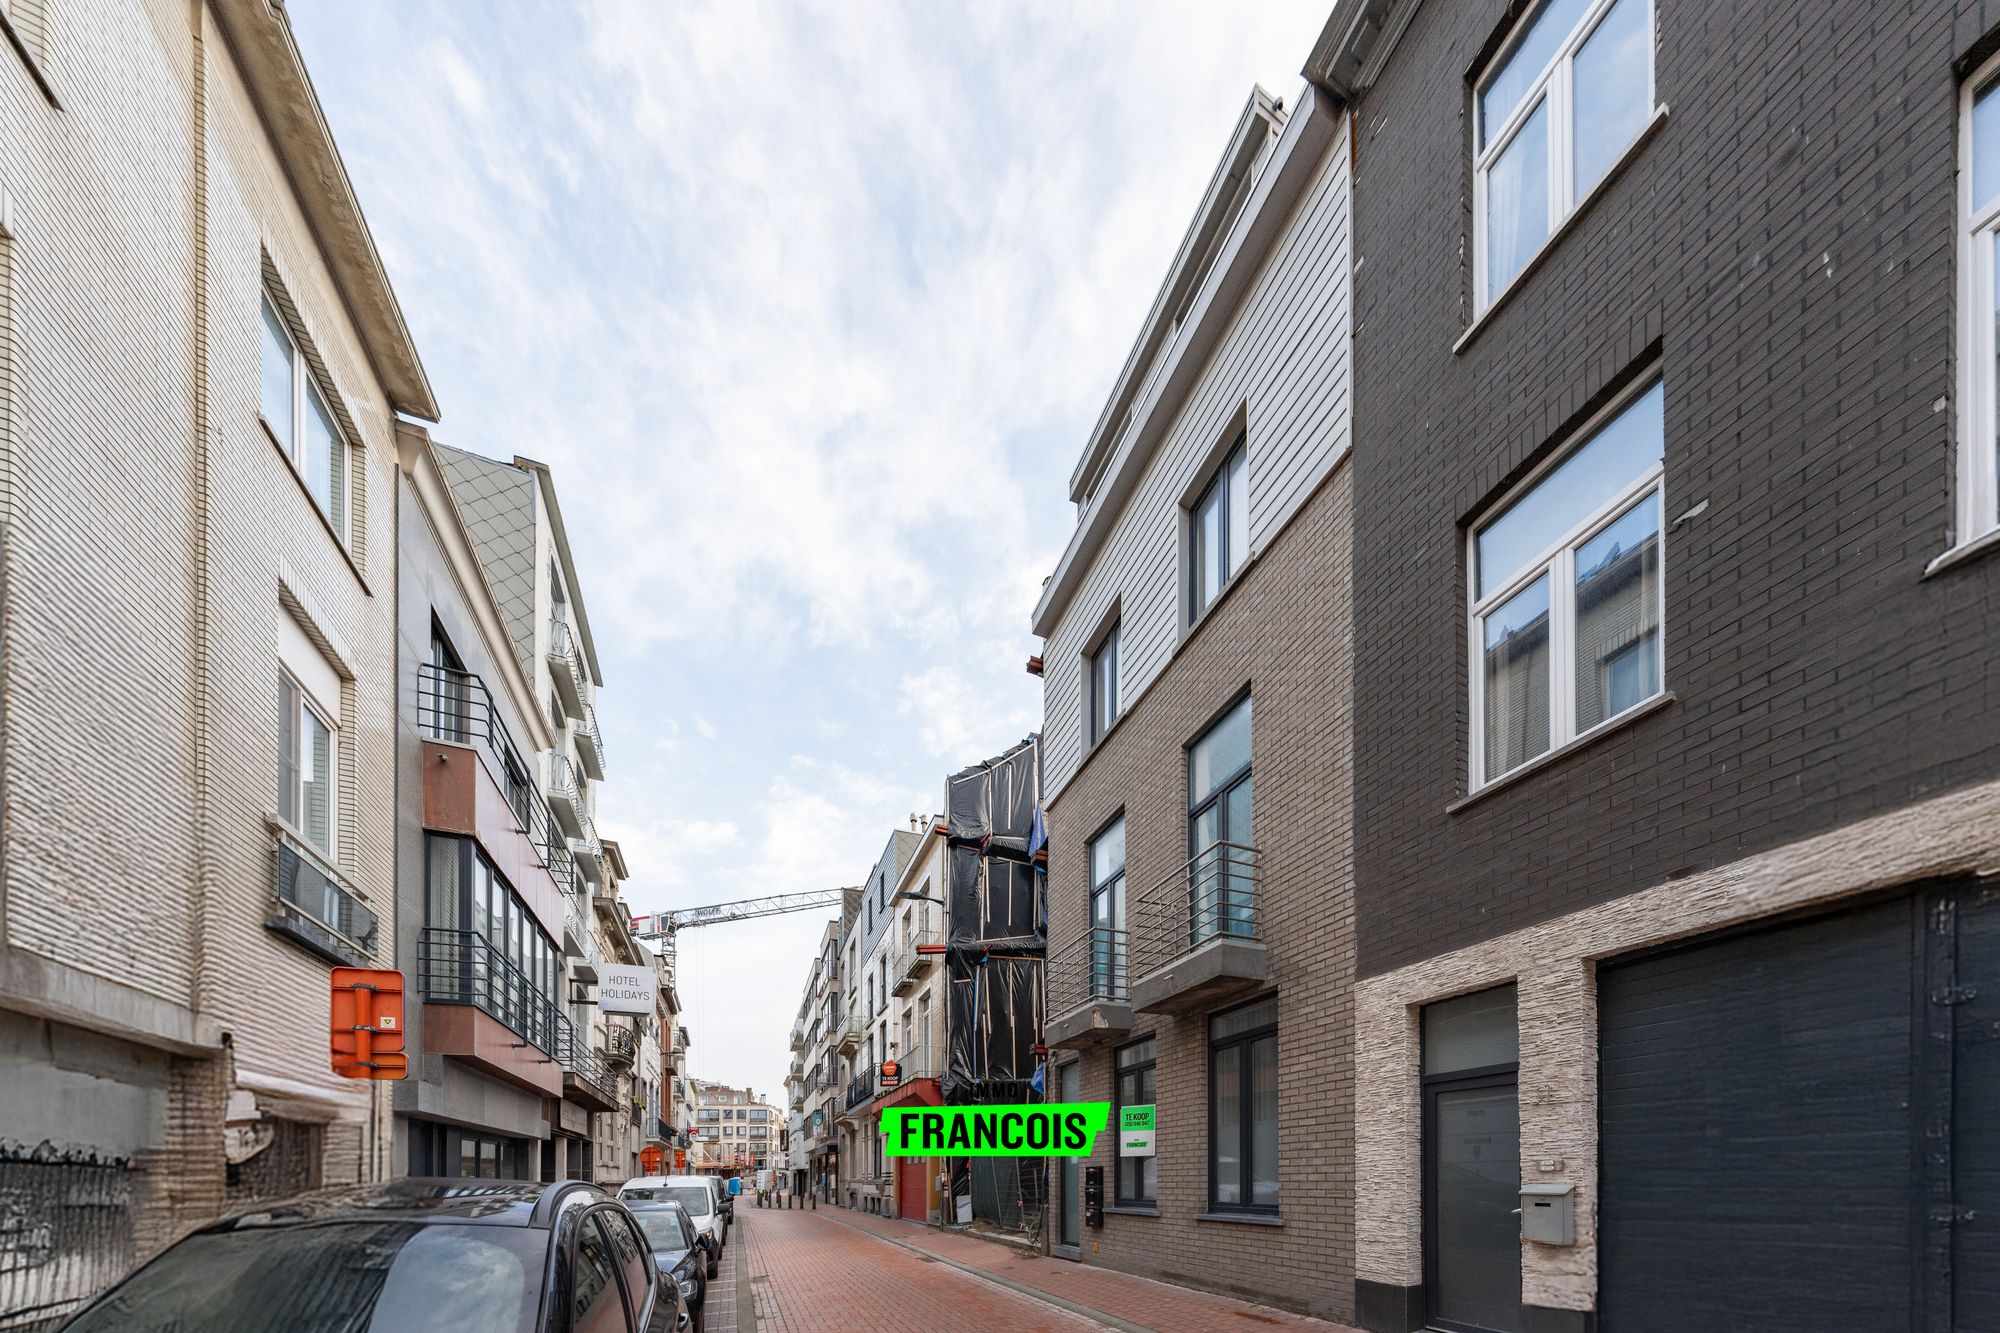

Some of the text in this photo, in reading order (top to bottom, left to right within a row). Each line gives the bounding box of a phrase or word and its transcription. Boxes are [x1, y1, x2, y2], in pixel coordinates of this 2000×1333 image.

[697, 907, 720, 916] WOLFF
[609, 975, 641, 987] HOTEL
[601, 988, 650, 1001] HOLIDAYS
[1125, 1112, 1150, 1121] TE KOOP
